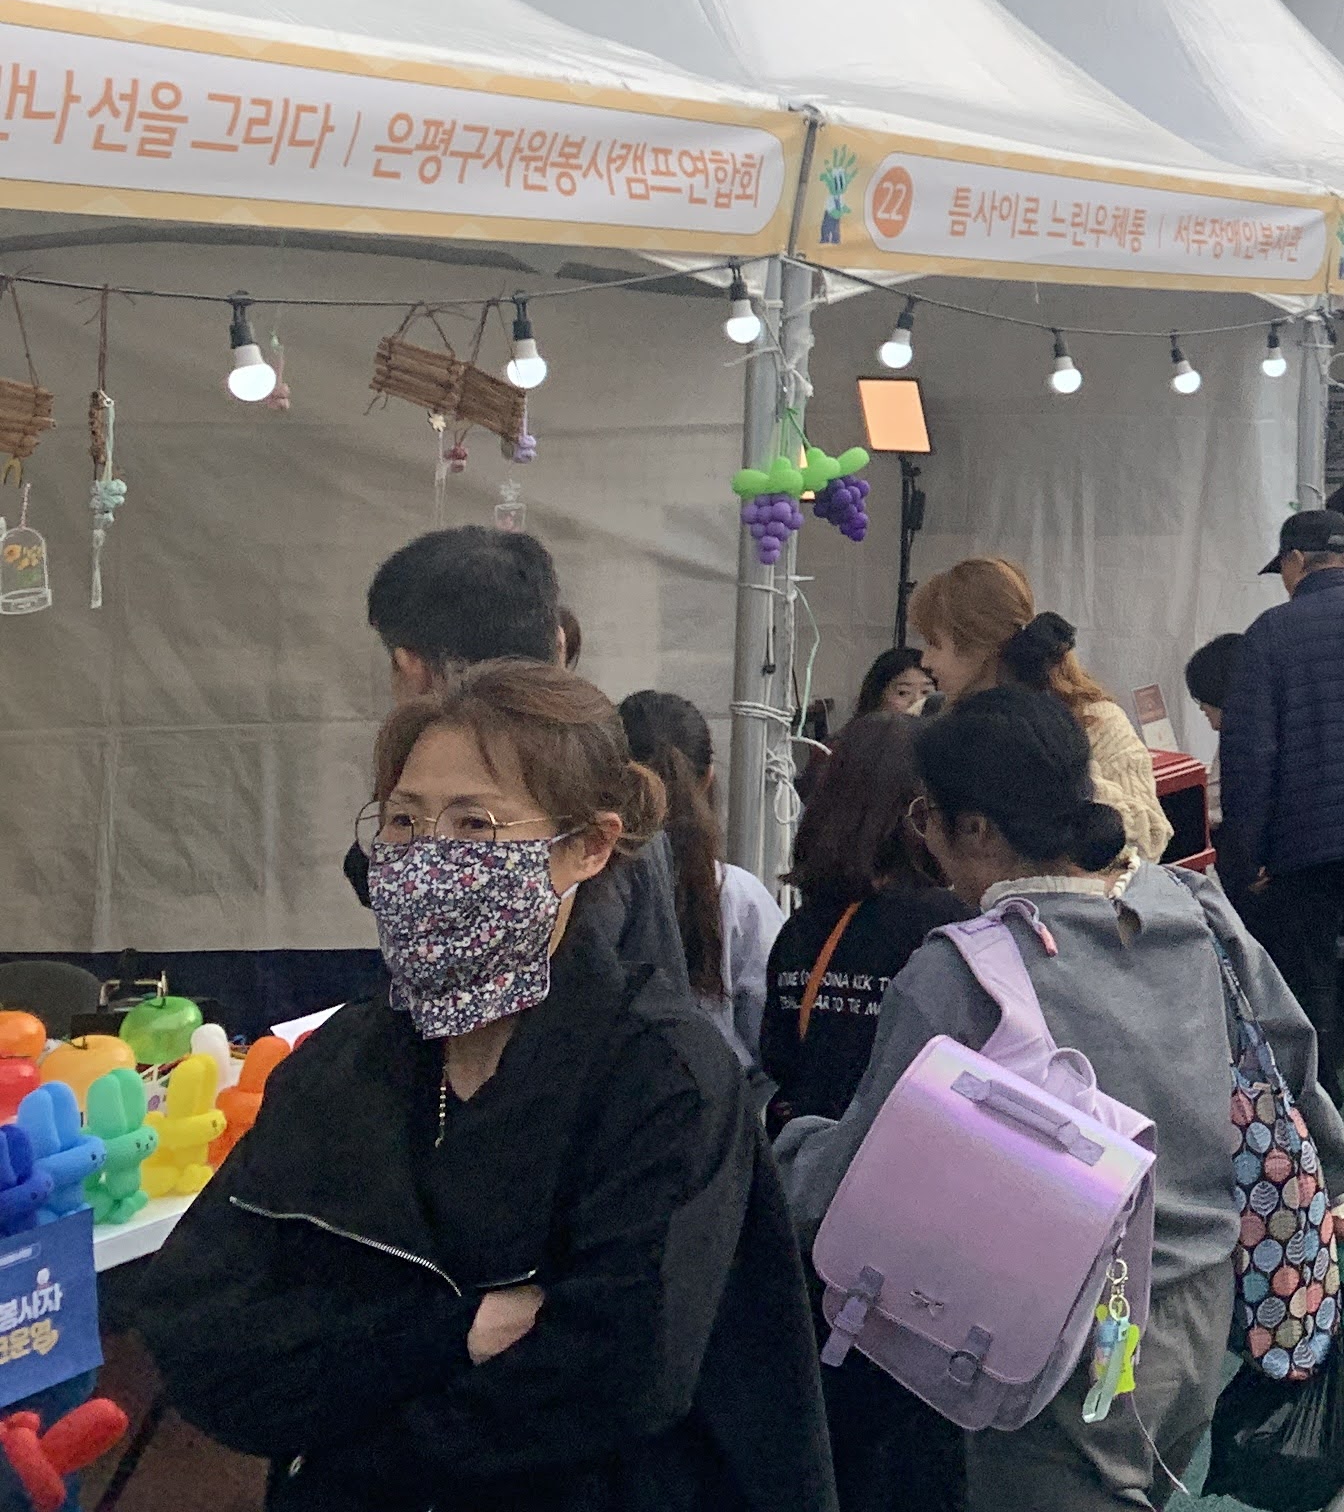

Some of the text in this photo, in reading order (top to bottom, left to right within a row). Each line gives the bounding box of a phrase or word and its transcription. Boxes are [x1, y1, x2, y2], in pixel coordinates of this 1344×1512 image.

[87, 77, 190, 159] 선을
[190, 91, 340, 168] 그리다
[371, 110, 767, 211] 은평구자원봉사캠프연합회
[876, 181, 906, 221] 22
[948, 186, 1041, 238] 틈사이로
[1046, 199, 1148, 255] 느린우체통
